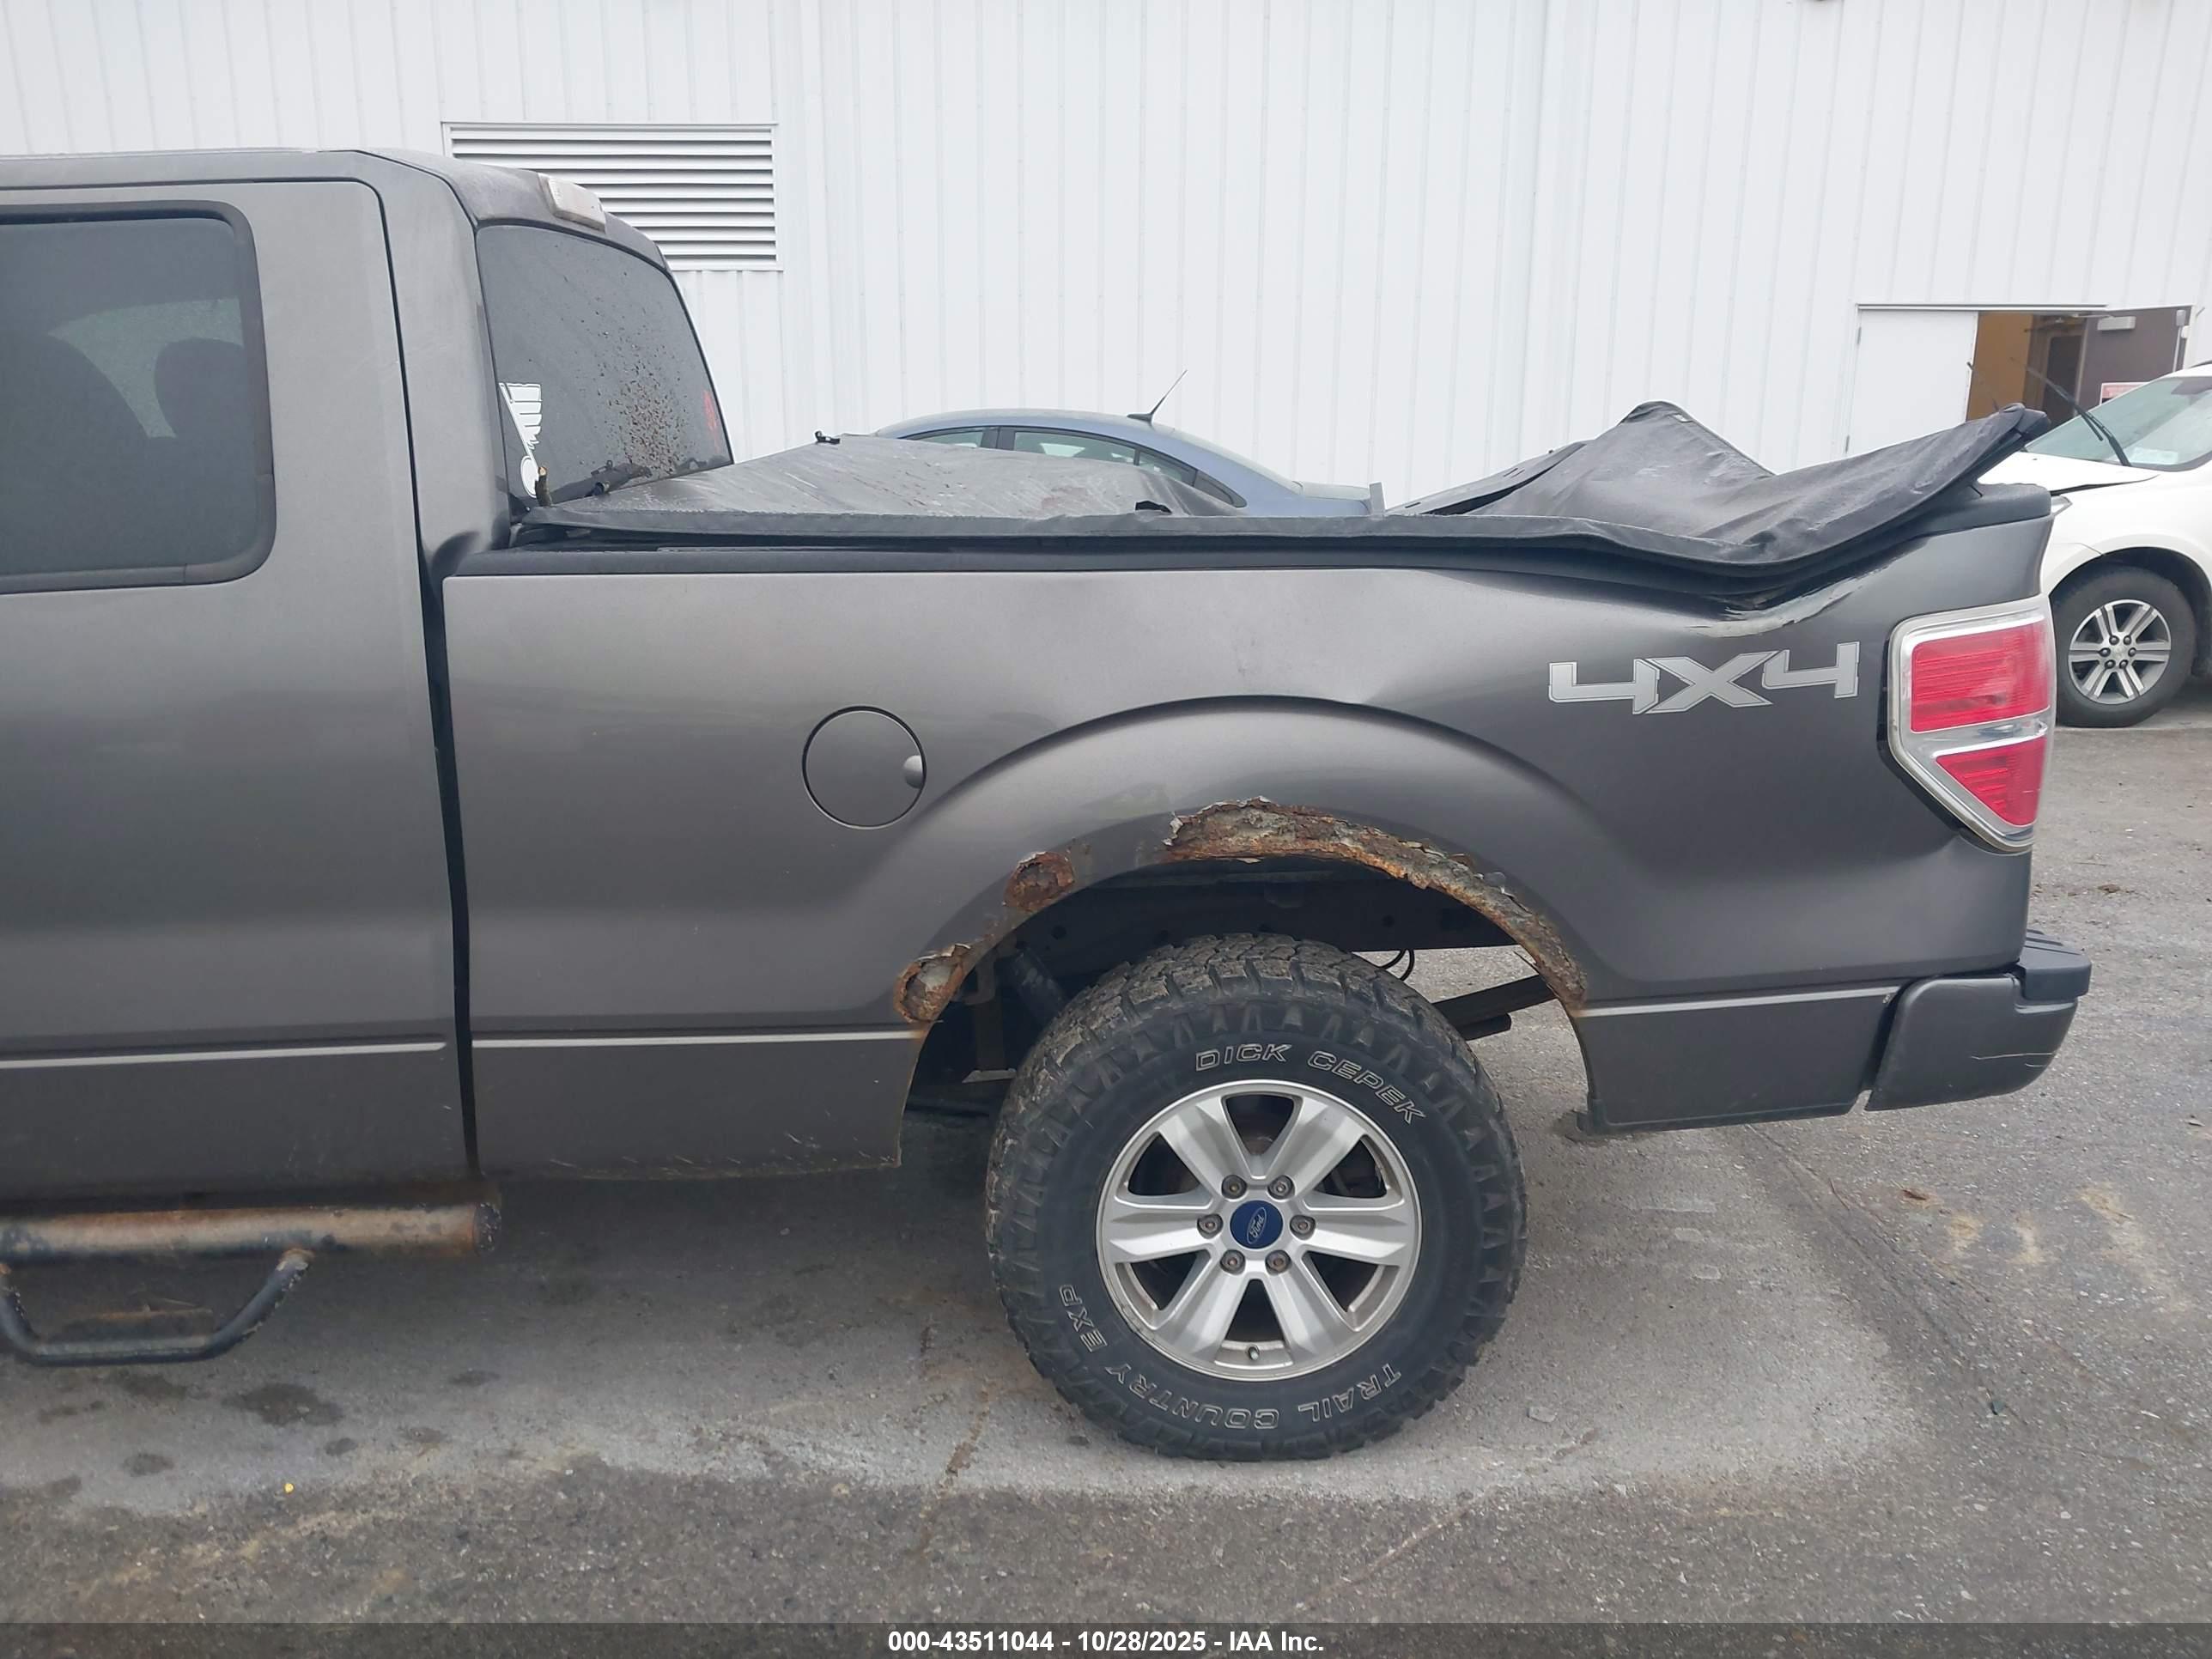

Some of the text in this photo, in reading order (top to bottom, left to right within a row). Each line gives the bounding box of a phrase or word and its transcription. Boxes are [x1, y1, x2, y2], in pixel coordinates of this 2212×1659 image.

[1195, 1043, 1426, 1125] DICK CEPEK
[1059, 1284, 1402, 1430] TRAIL COUNTRY EXP
